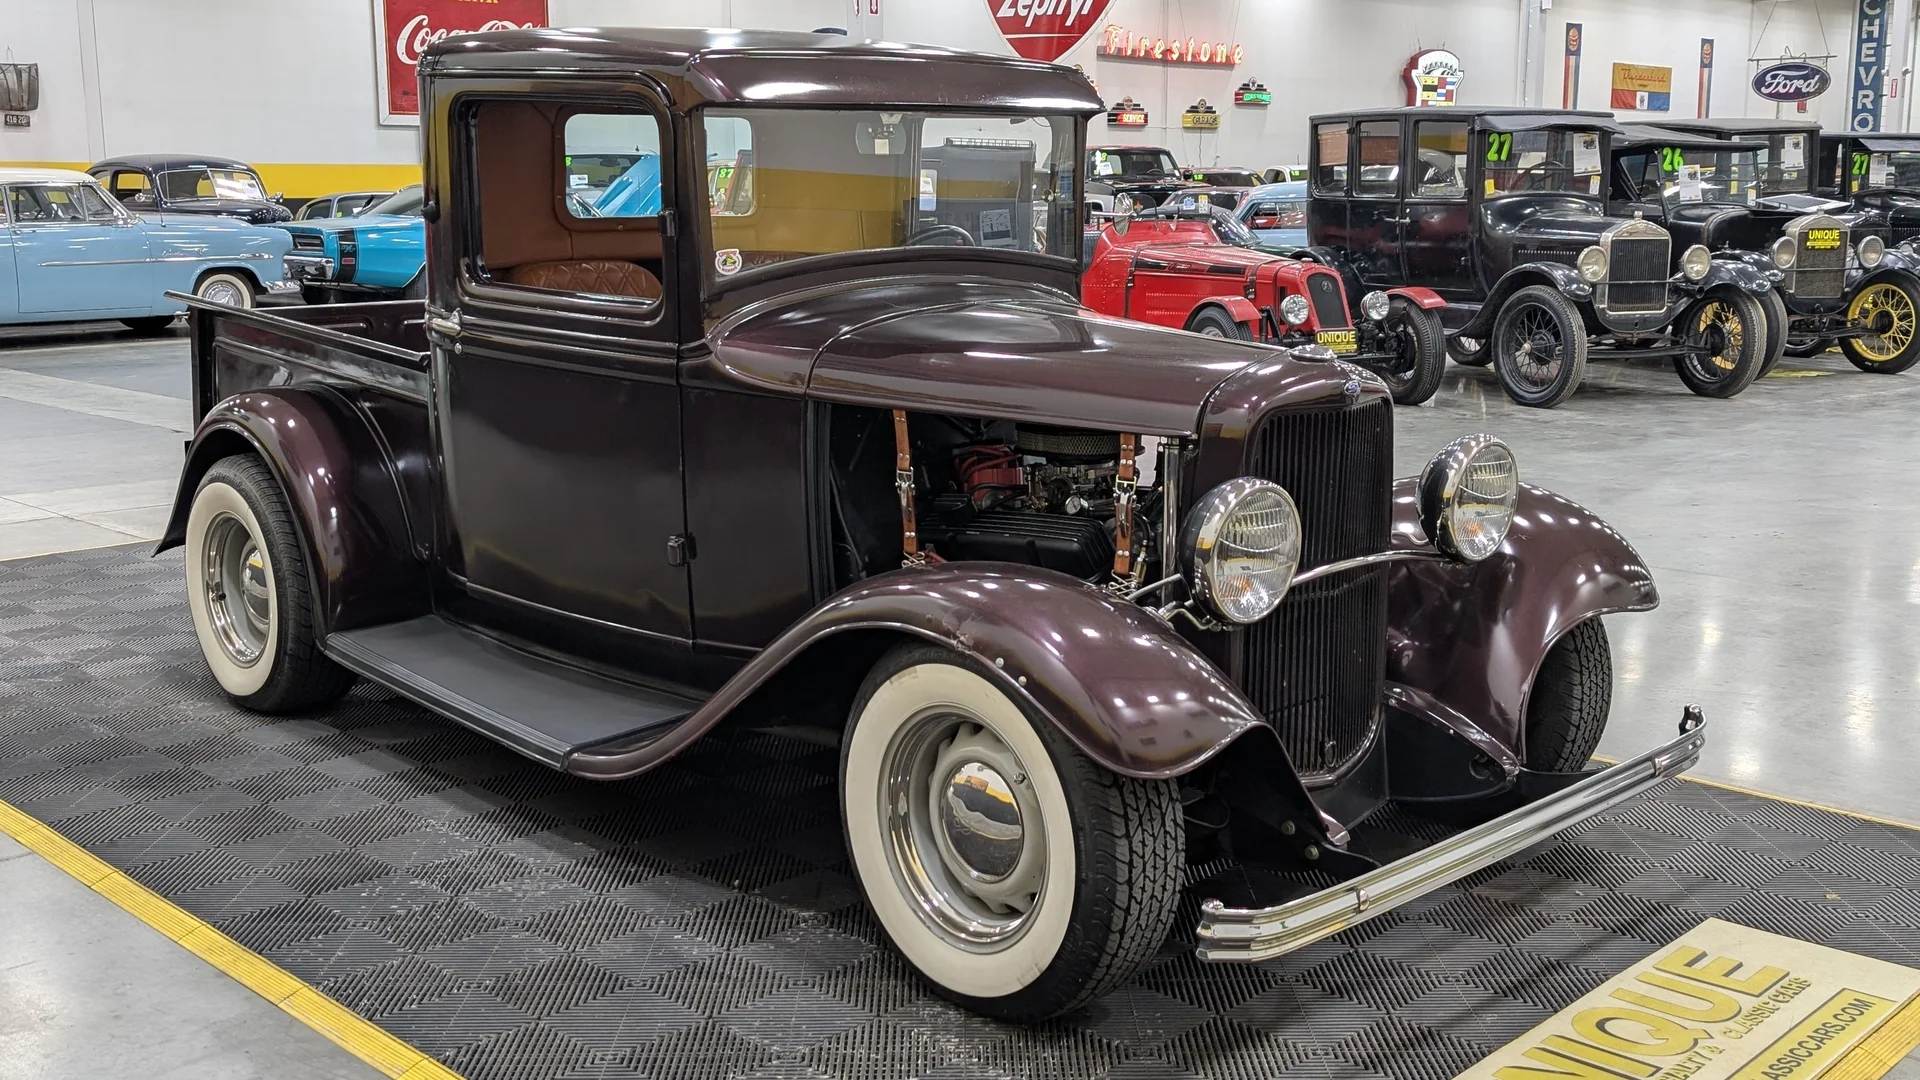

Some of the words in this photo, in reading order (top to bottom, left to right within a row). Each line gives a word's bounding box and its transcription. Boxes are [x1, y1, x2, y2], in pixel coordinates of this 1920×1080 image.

[996, 0, 1092, 27] Zephyr
[1104, 24, 1244, 65] Firestone
[1621, 68, 1666, 82] Thunderbird
[1761, 70, 1820, 94] Ford
[1122, 113, 1145, 123] SERVICE
[1487, 132, 1512, 161] 27
[1662, 146, 1684, 172] 26
[1852, 154, 1869, 175] 27
[719, 168, 735, 179] 87
[1808, 229, 1840, 239] UNIQUE
[1317, 331, 1356, 343] UNIQUE
[1719, 1000, 1781, 1040] CLASSIC
[1767, 976, 1813, 1004] CARS
